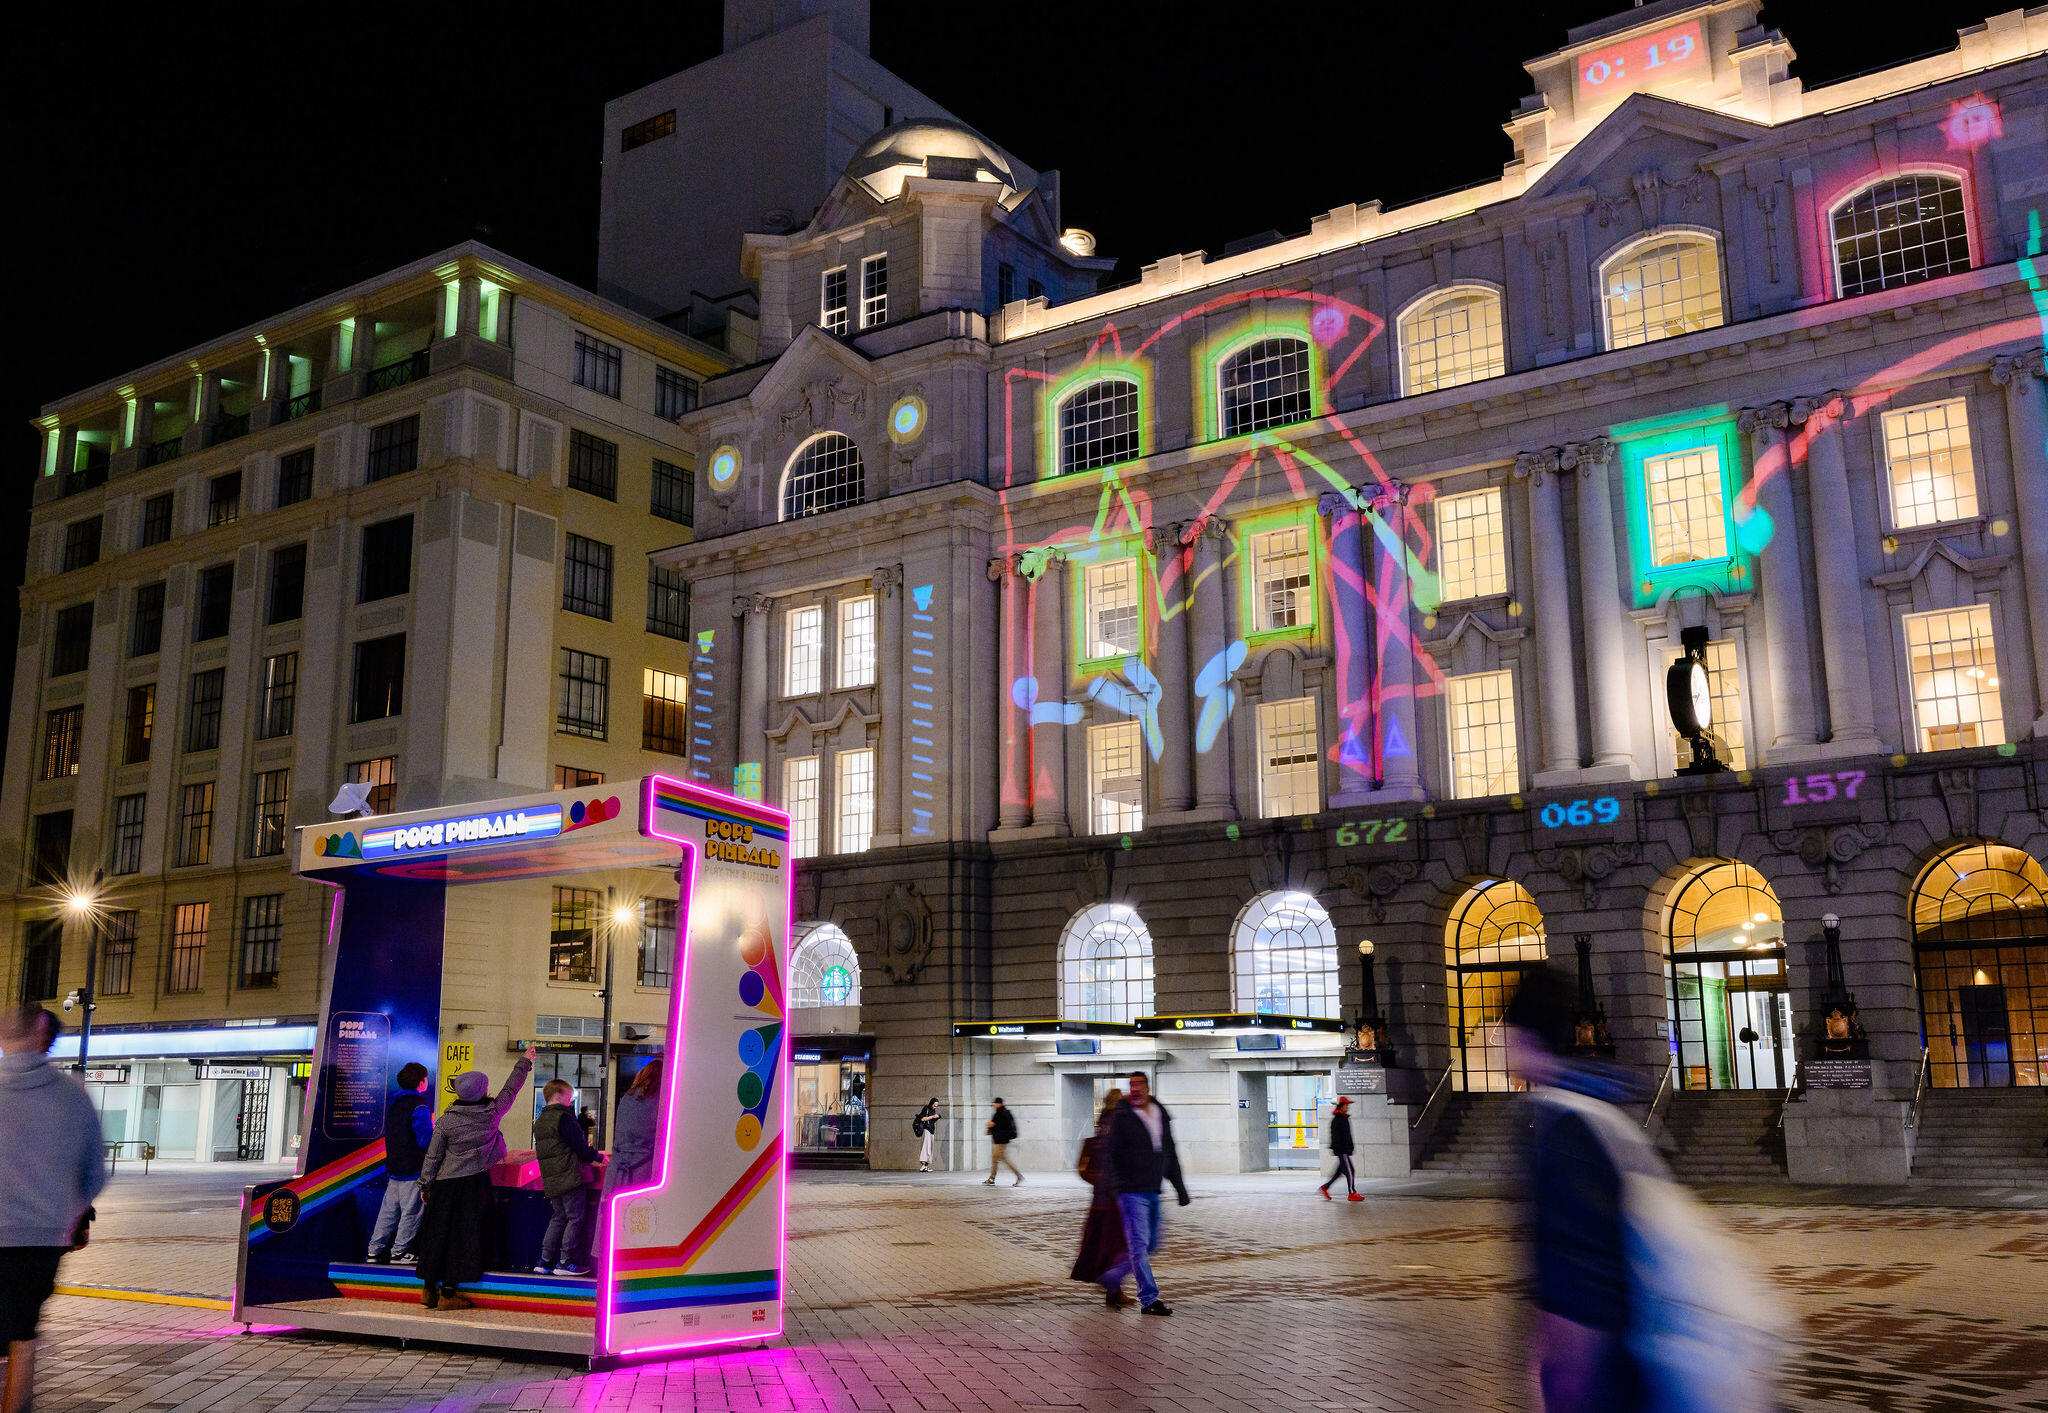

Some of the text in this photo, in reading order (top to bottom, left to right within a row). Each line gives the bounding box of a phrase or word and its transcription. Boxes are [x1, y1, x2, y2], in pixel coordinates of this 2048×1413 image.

[1782, 770, 1866, 805] 157
[1540, 796, 1620, 828] 069
[393, 813, 529, 851] POPS PINBALL
[705, 818, 754, 844] POPS
[1336, 818, 1408, 847] 672
[705, 840, 781, 869] PINBALL
[704, 865, 724, 876] PLAY
[742, 871, 780, 884] BUILDING
[338, 1030, 378, 1040] PINBALL
[339, 1020, 365, 1030] POPS
[446, 1045, 470, 1061] CAFE
